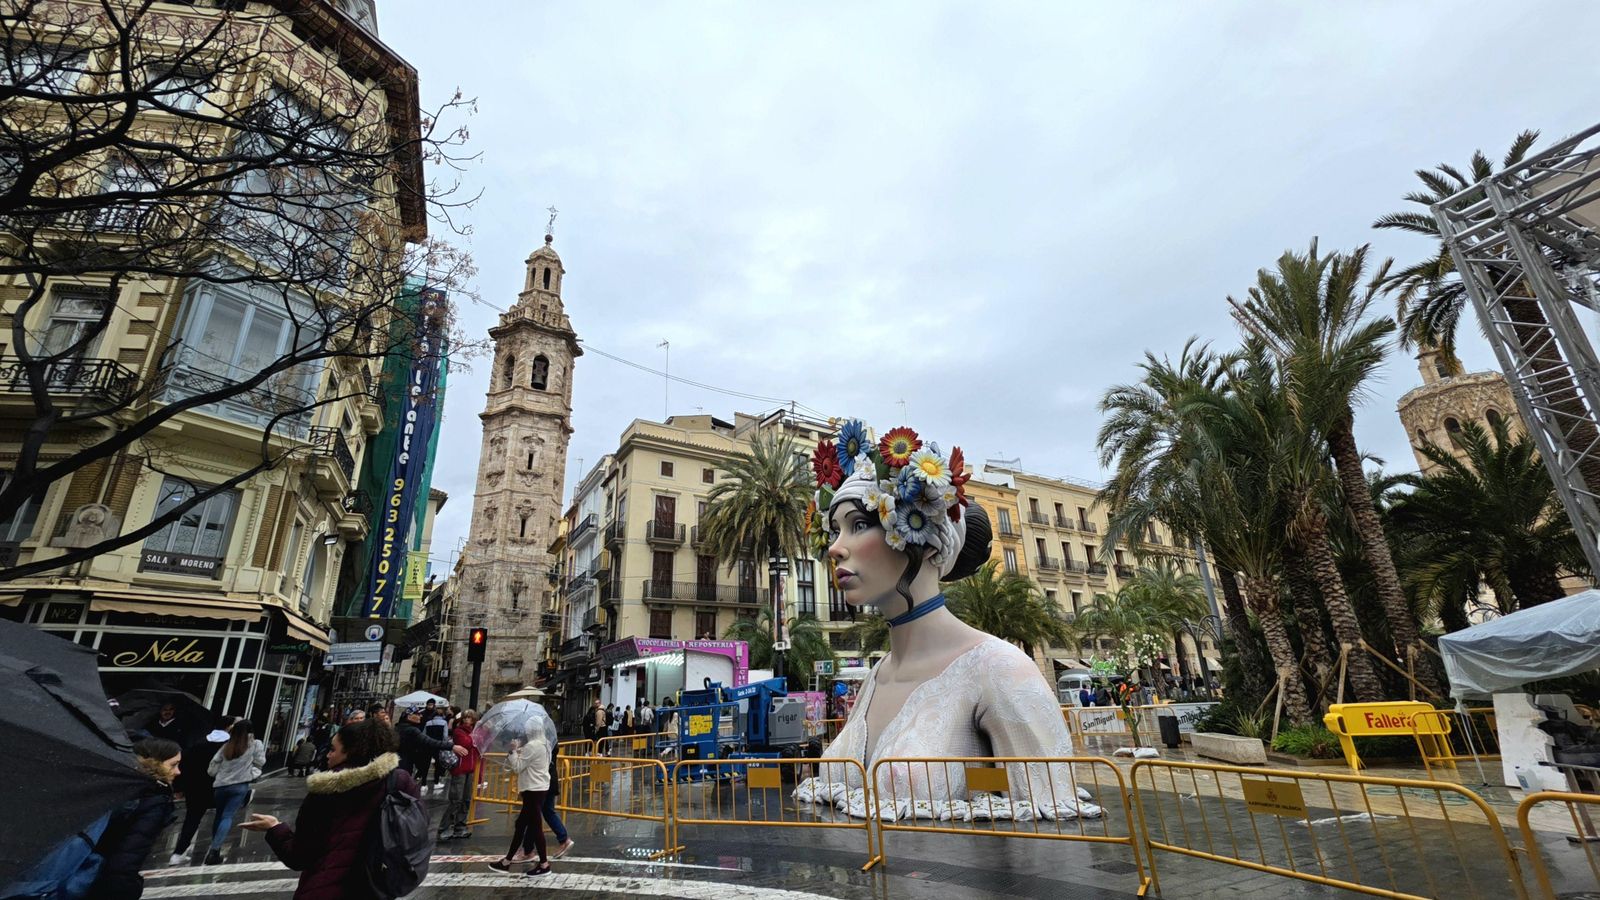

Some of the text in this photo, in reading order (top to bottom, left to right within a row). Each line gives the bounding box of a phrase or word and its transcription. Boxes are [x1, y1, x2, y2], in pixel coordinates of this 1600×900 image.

[146, 554, 215, 569] SALA MORENO
[637, 639, 680, 648] CHOCOLATERIA
[113, 637, 205, 667] Nela
[777, 713, 798, 724] rigar
[1364, 711, 1416, 728] Fallera
